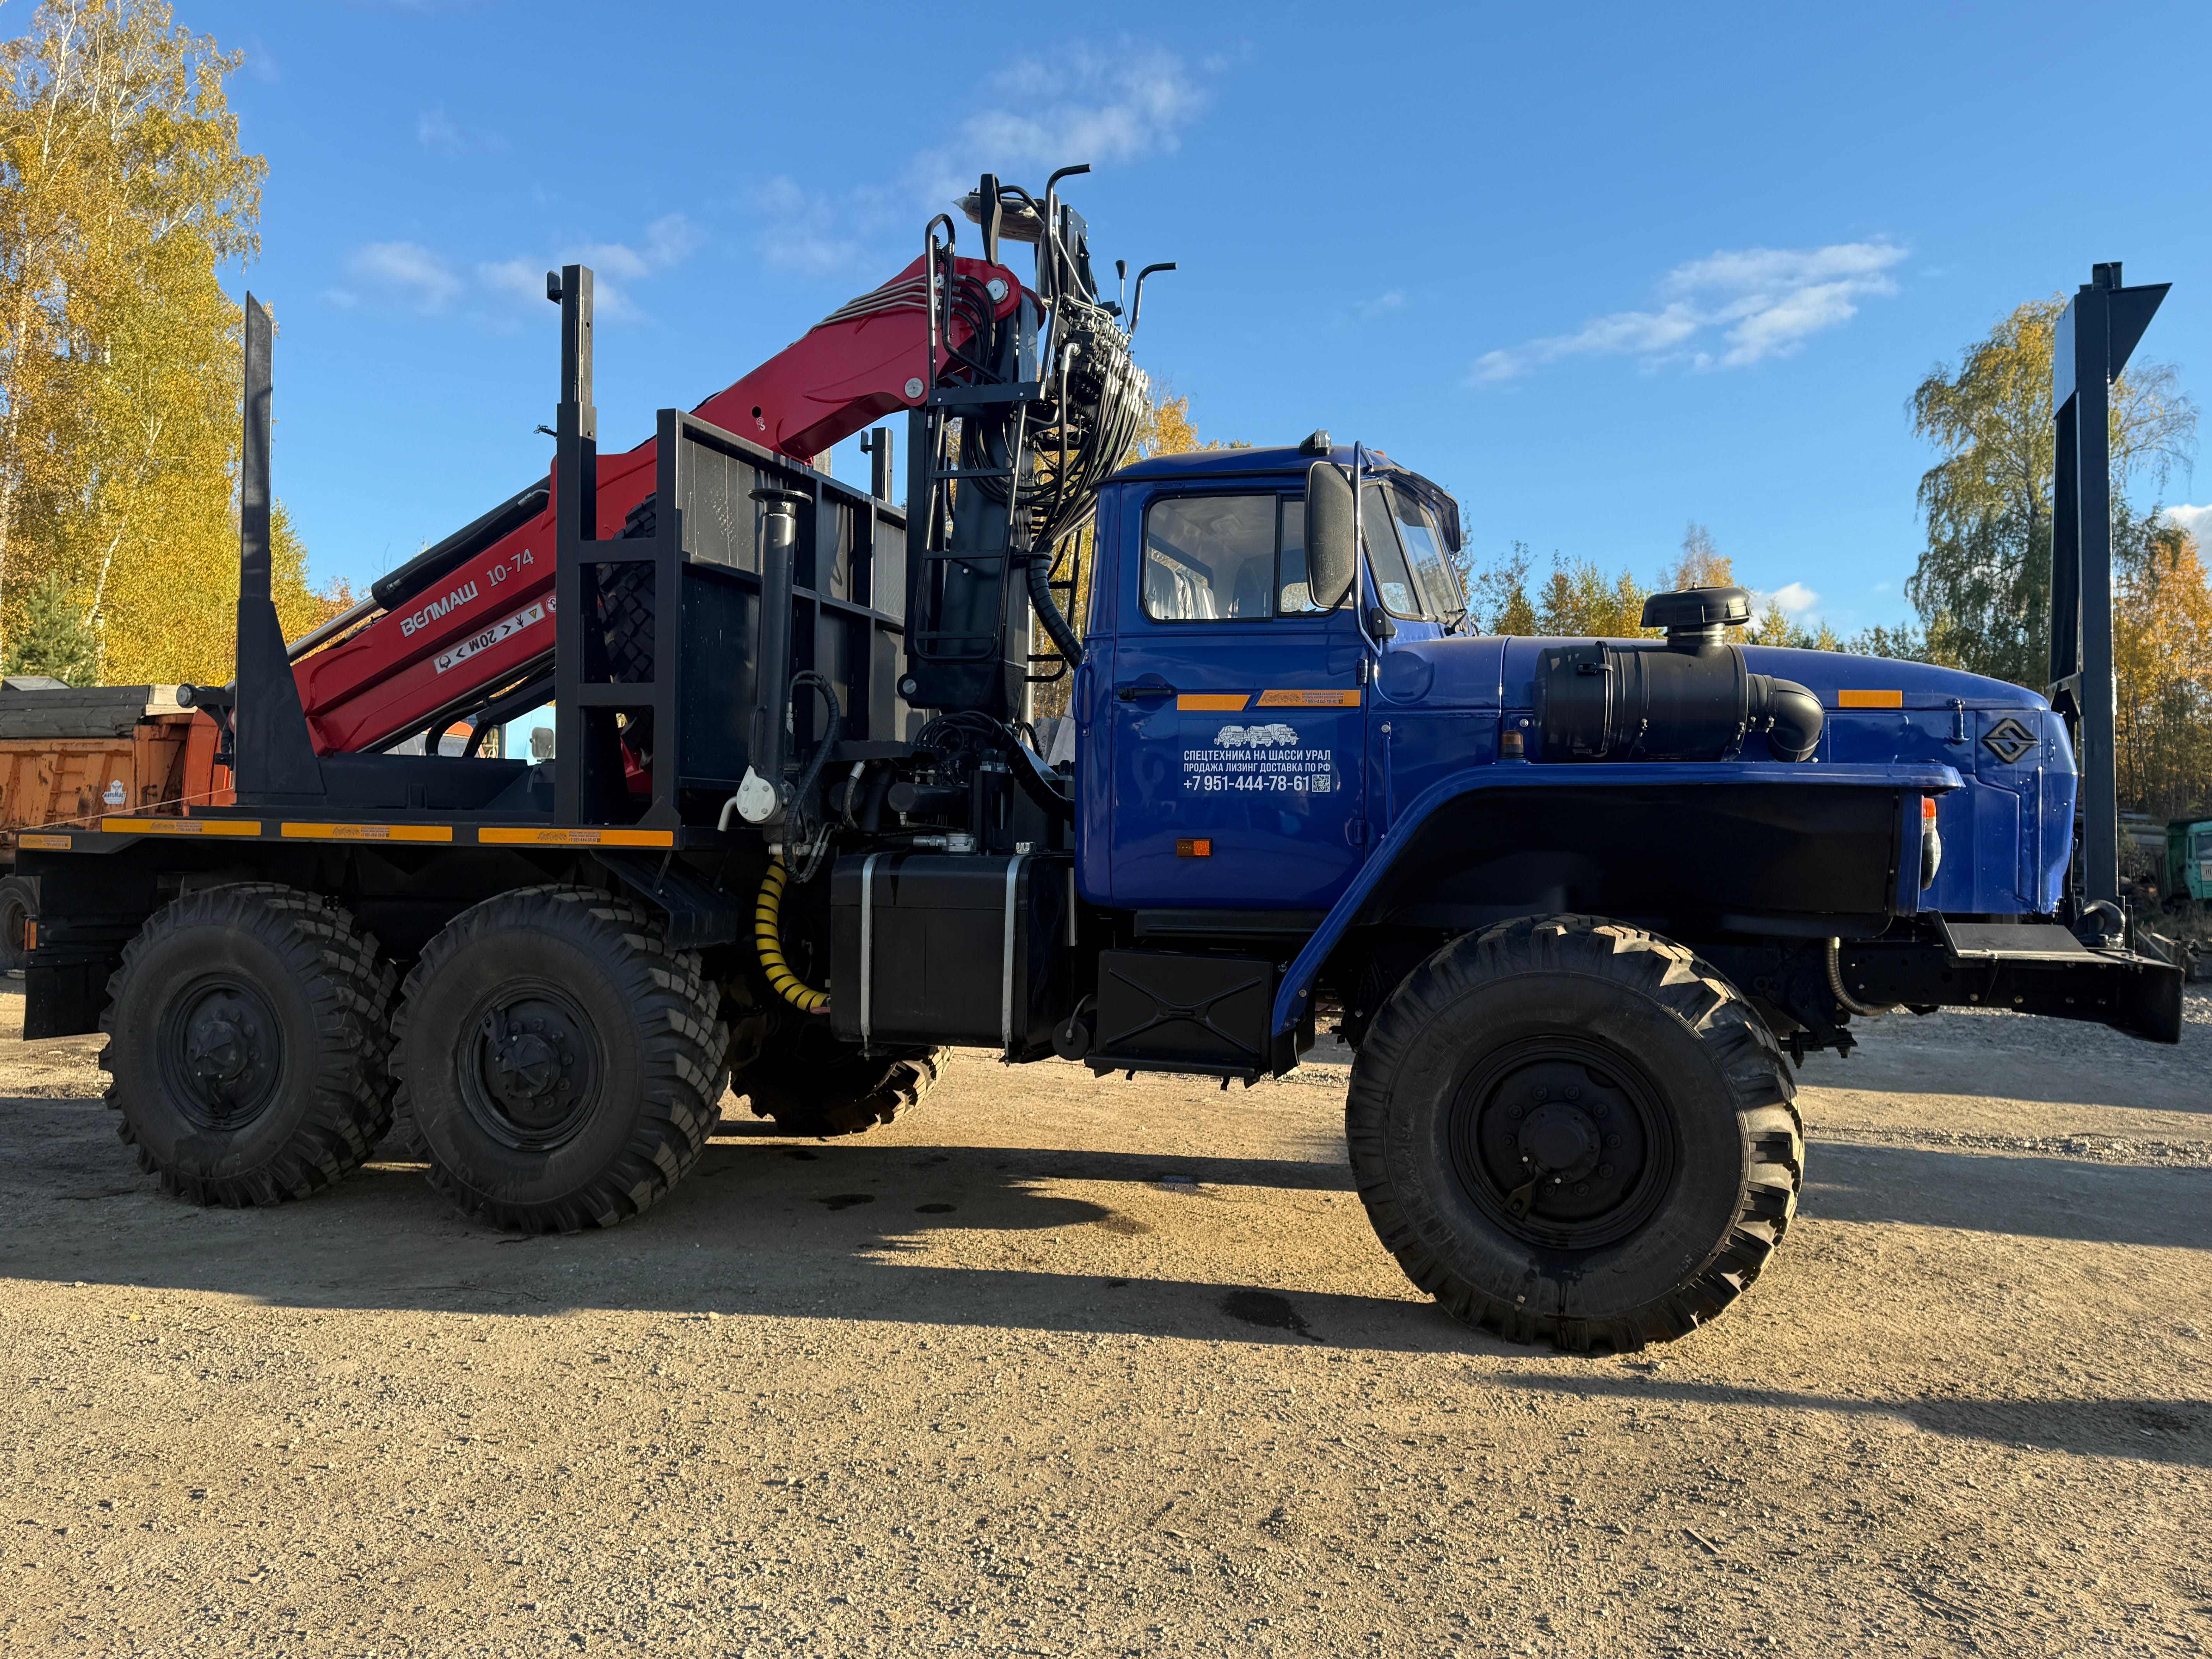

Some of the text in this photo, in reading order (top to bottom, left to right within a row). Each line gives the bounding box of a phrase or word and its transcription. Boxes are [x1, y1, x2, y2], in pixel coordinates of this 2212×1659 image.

[400, 548, 534, 638] ВЕЛМАШ 10-74
[1183, 750, 1331, 762] СПЕЦТЕХНИКА НА ШАССИ УРАЛ
[1183, 763, 1330, 773] ПРОДАЖА ЛИЗИНГ ДОСТАВКА ПО РФ
[1183, 775, 1309, 791] +7 951-444-78-61
